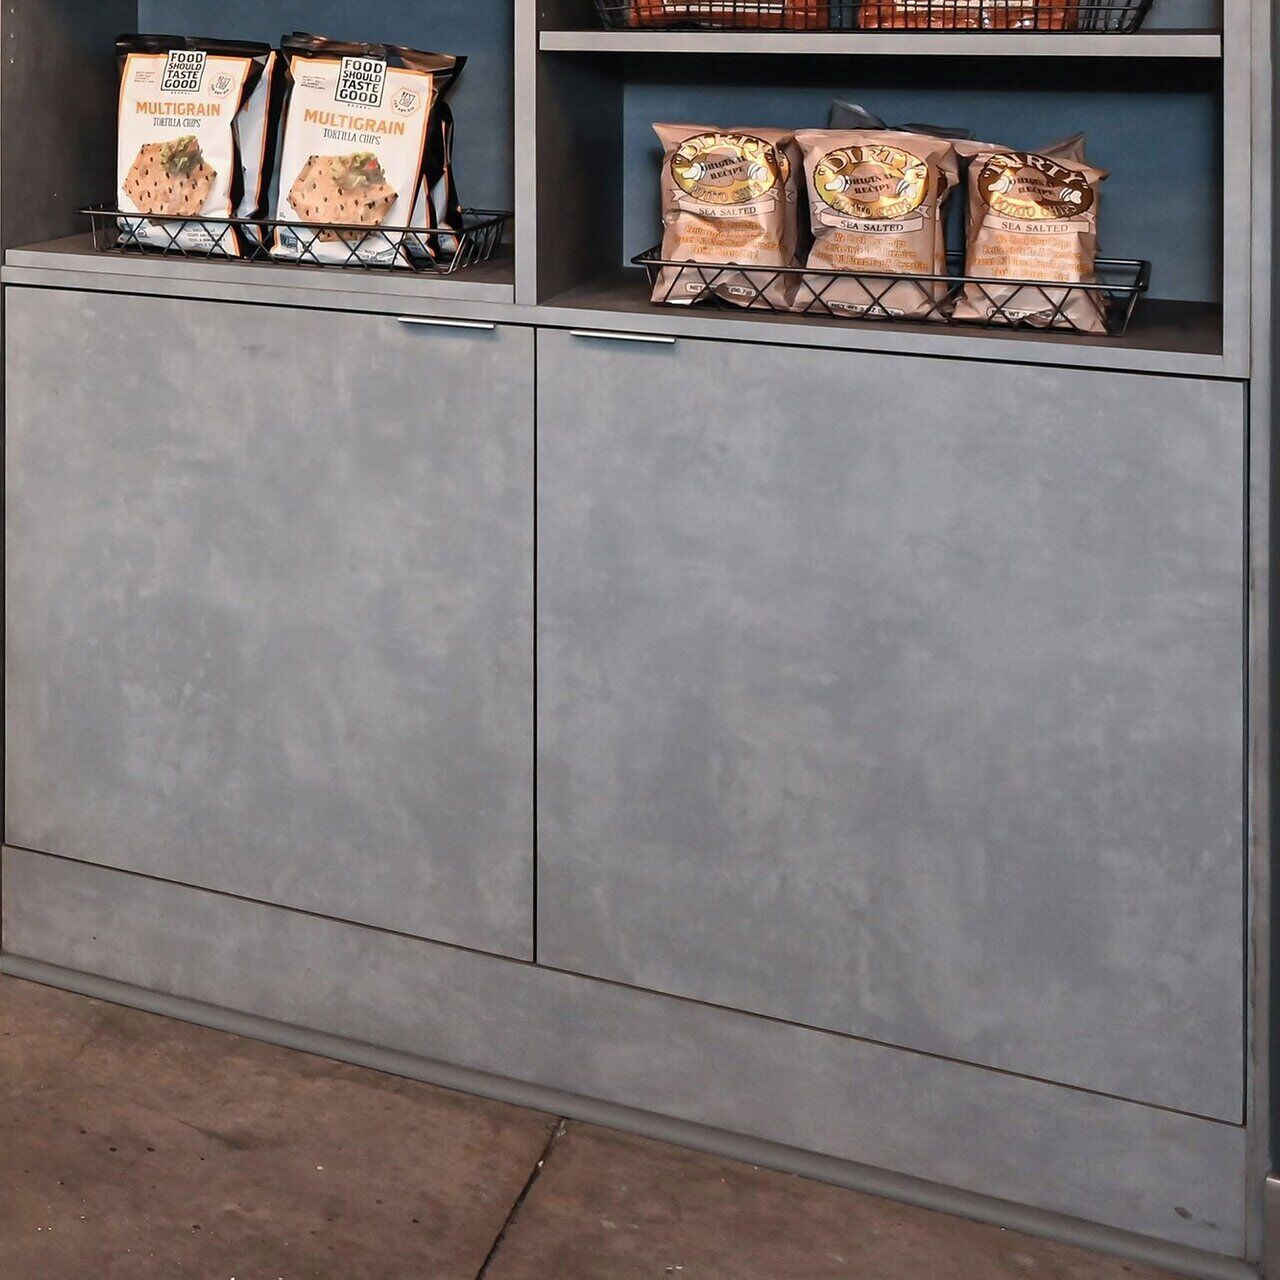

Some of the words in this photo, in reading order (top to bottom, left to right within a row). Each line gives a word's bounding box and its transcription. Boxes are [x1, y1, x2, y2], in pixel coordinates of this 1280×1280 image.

[170, 52, 203, 63] FOOD
[168, 63, 202, 71] SHOULD
[344, 59, 383, 74] FOOD
[167, 70, 200, 79] TASTE
[342, 70, 382, 83] SHOULD
[164, 79, 197, 89] GOOD
[342, 78, 380, 93] TASTE
[339, 89, 378, 104] GOOD
[136, 101, 221, 116] MULTIGRAIN
[303, 108, 405, 135] MULTIGRAIN
[323, 128, 357, 143] TORTILLA
[359, 133, 382, 145] CHIPS
[678, 133, 773, 162] DIRTY
[820, 145, 925, 176] DIRTY
[698, 207, 716, 216] SEA
[719, 206, 757, 216] SALTED
[840, 220, 859, 230] SEA
[863, 223, 904, 232] SALTED
[1001, 222, 1021, 231] SEA
[1026, 224, 1069, 232] SALTED
